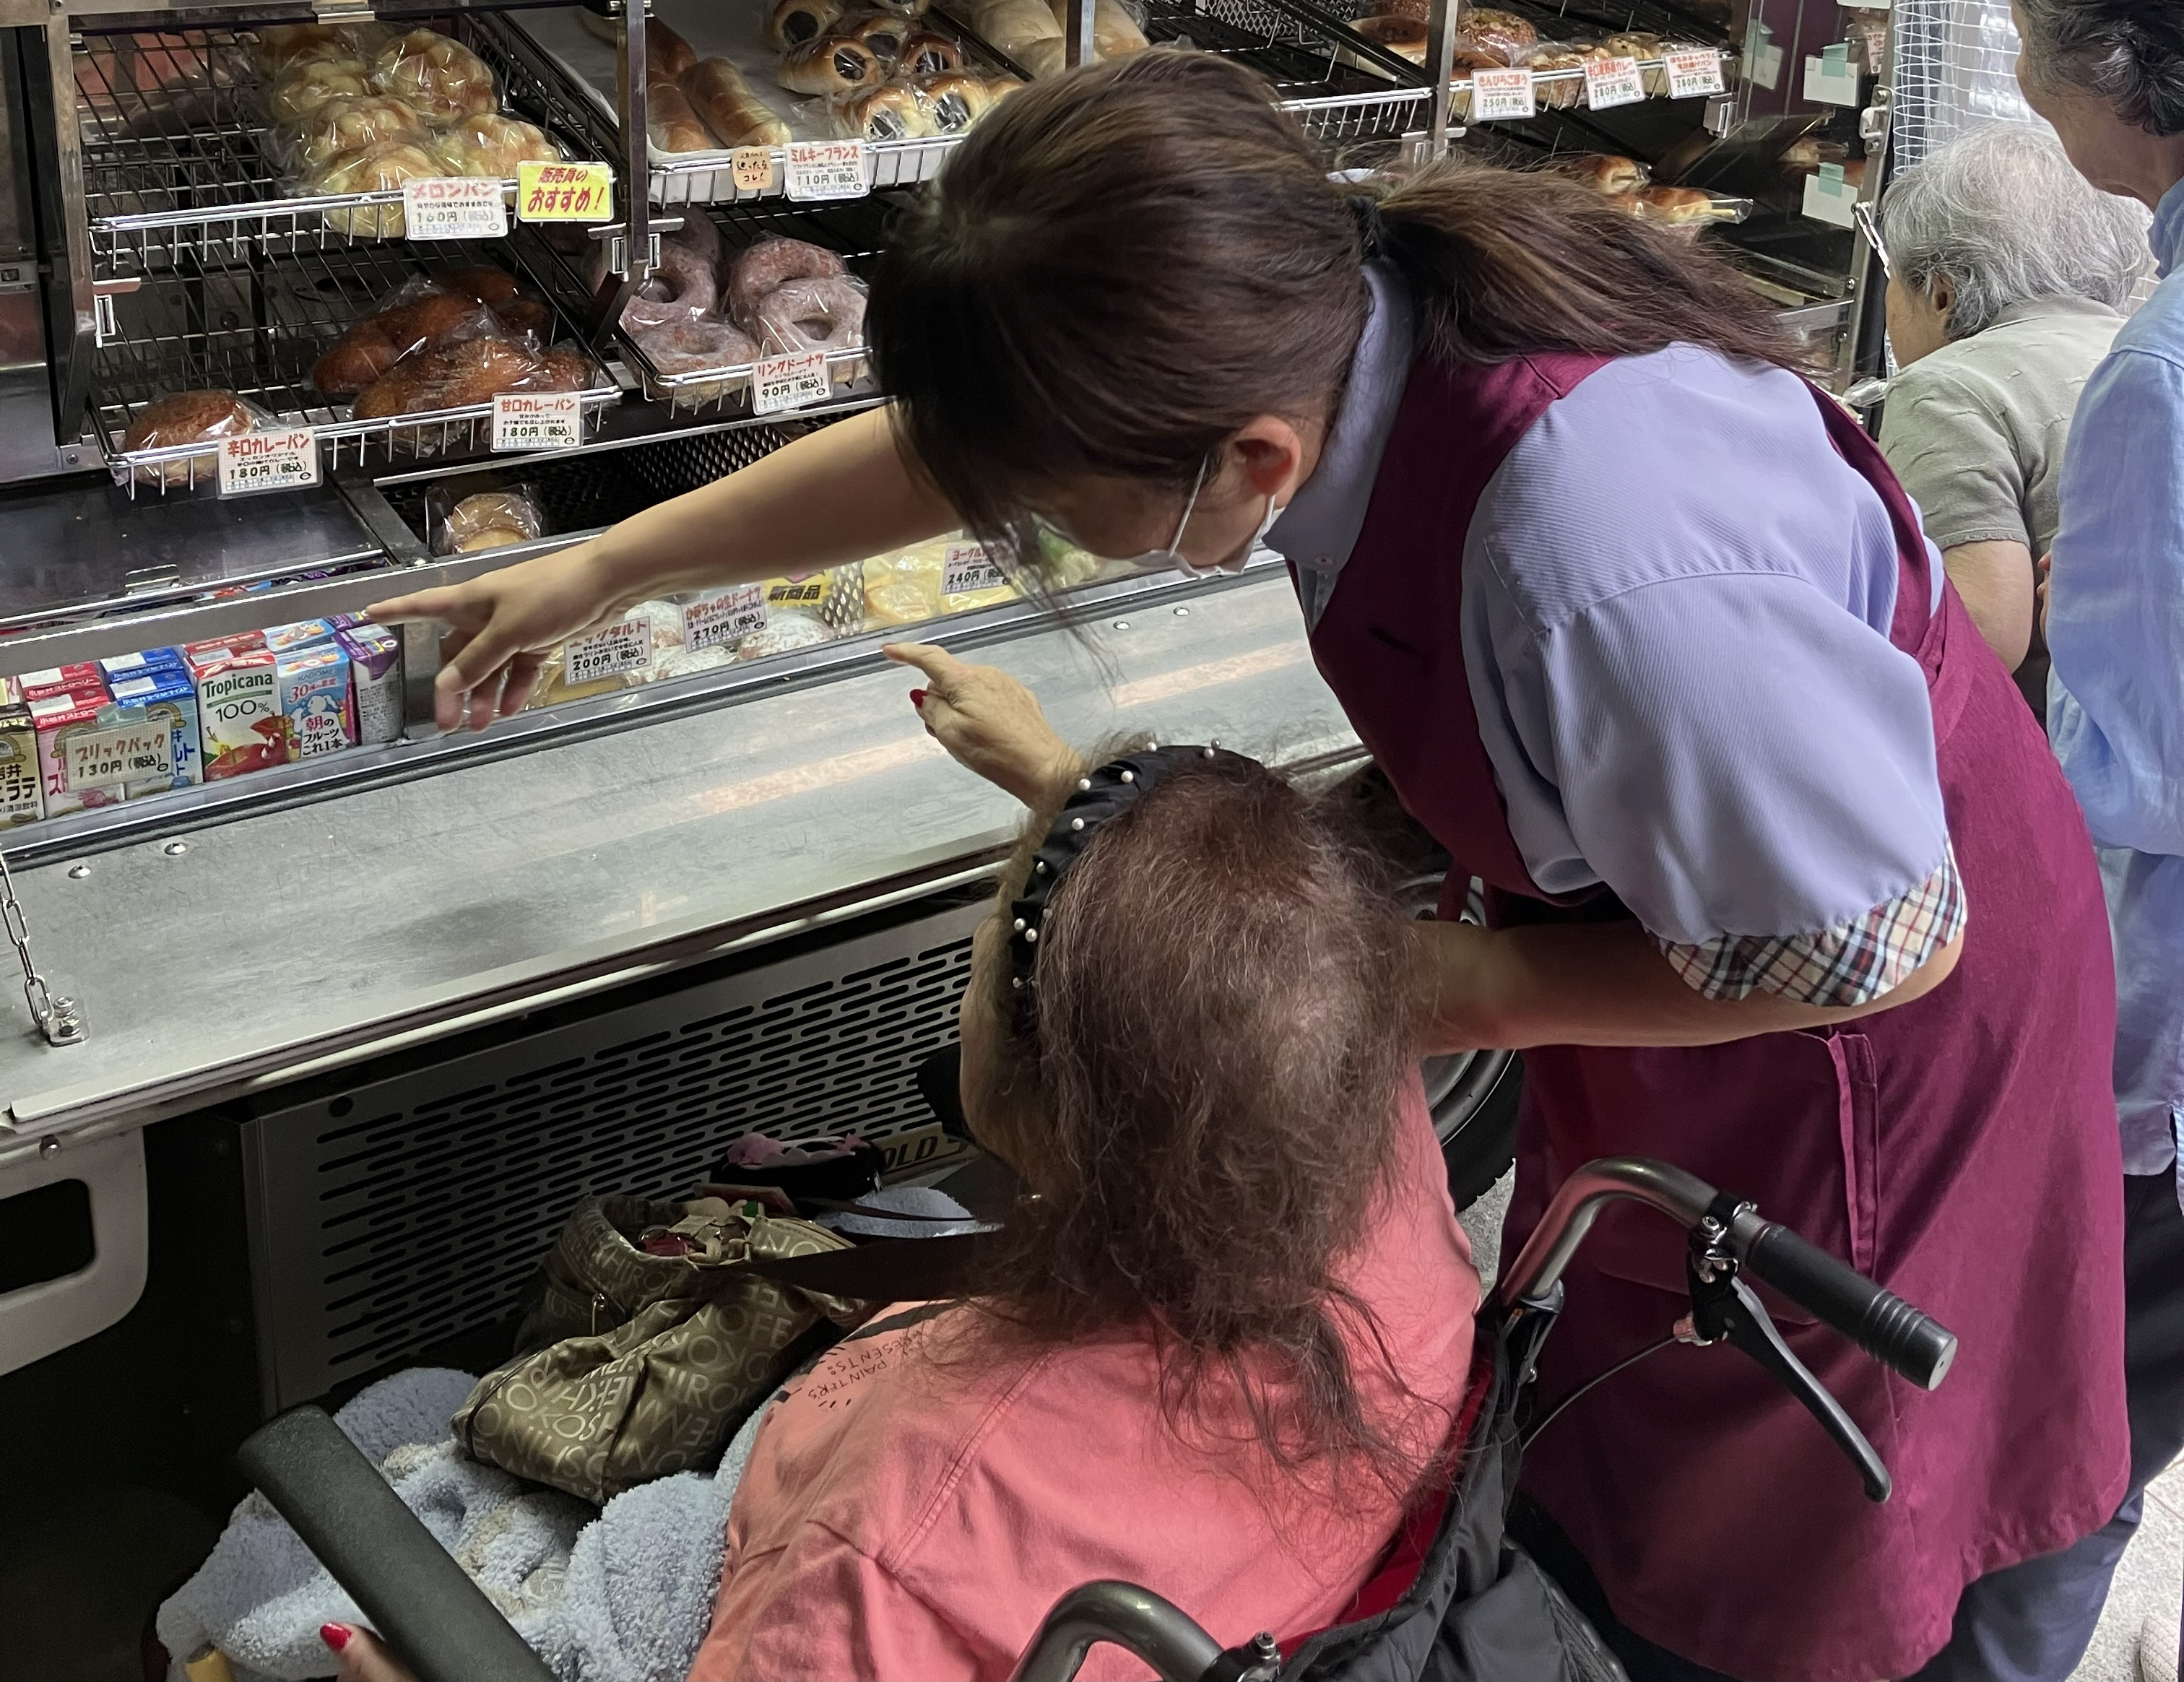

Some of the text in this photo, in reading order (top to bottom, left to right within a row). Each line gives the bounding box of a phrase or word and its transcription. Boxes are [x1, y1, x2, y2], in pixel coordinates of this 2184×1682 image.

[1479, 74, 1527, 87] きんぴらごぼう
[791, 145, 858, 162] ミルキーフランス
[538, 167, 588, 183] 販売員の
[413, 183, 496, 199] メロンパン
[527, 186, 604, 212] おすすめ!
[758, 354, 824, 377] リングドーナツ
[500, 399, 576, 412] 甘口カレーパン
[228, 433, 309, 457] 辛口カレーパン
[953, 547, 986, 560] ヨーグル
[768, 585, 821, 601] 新商品
[298, 667, 334, 681] KAGOME
[202, 673, 273, 698] Tropicana
[215, 700, 269, 722] 100%
[306, 715, 334, 732] 朝の
[303, 728, 339, 744] フルーツ
